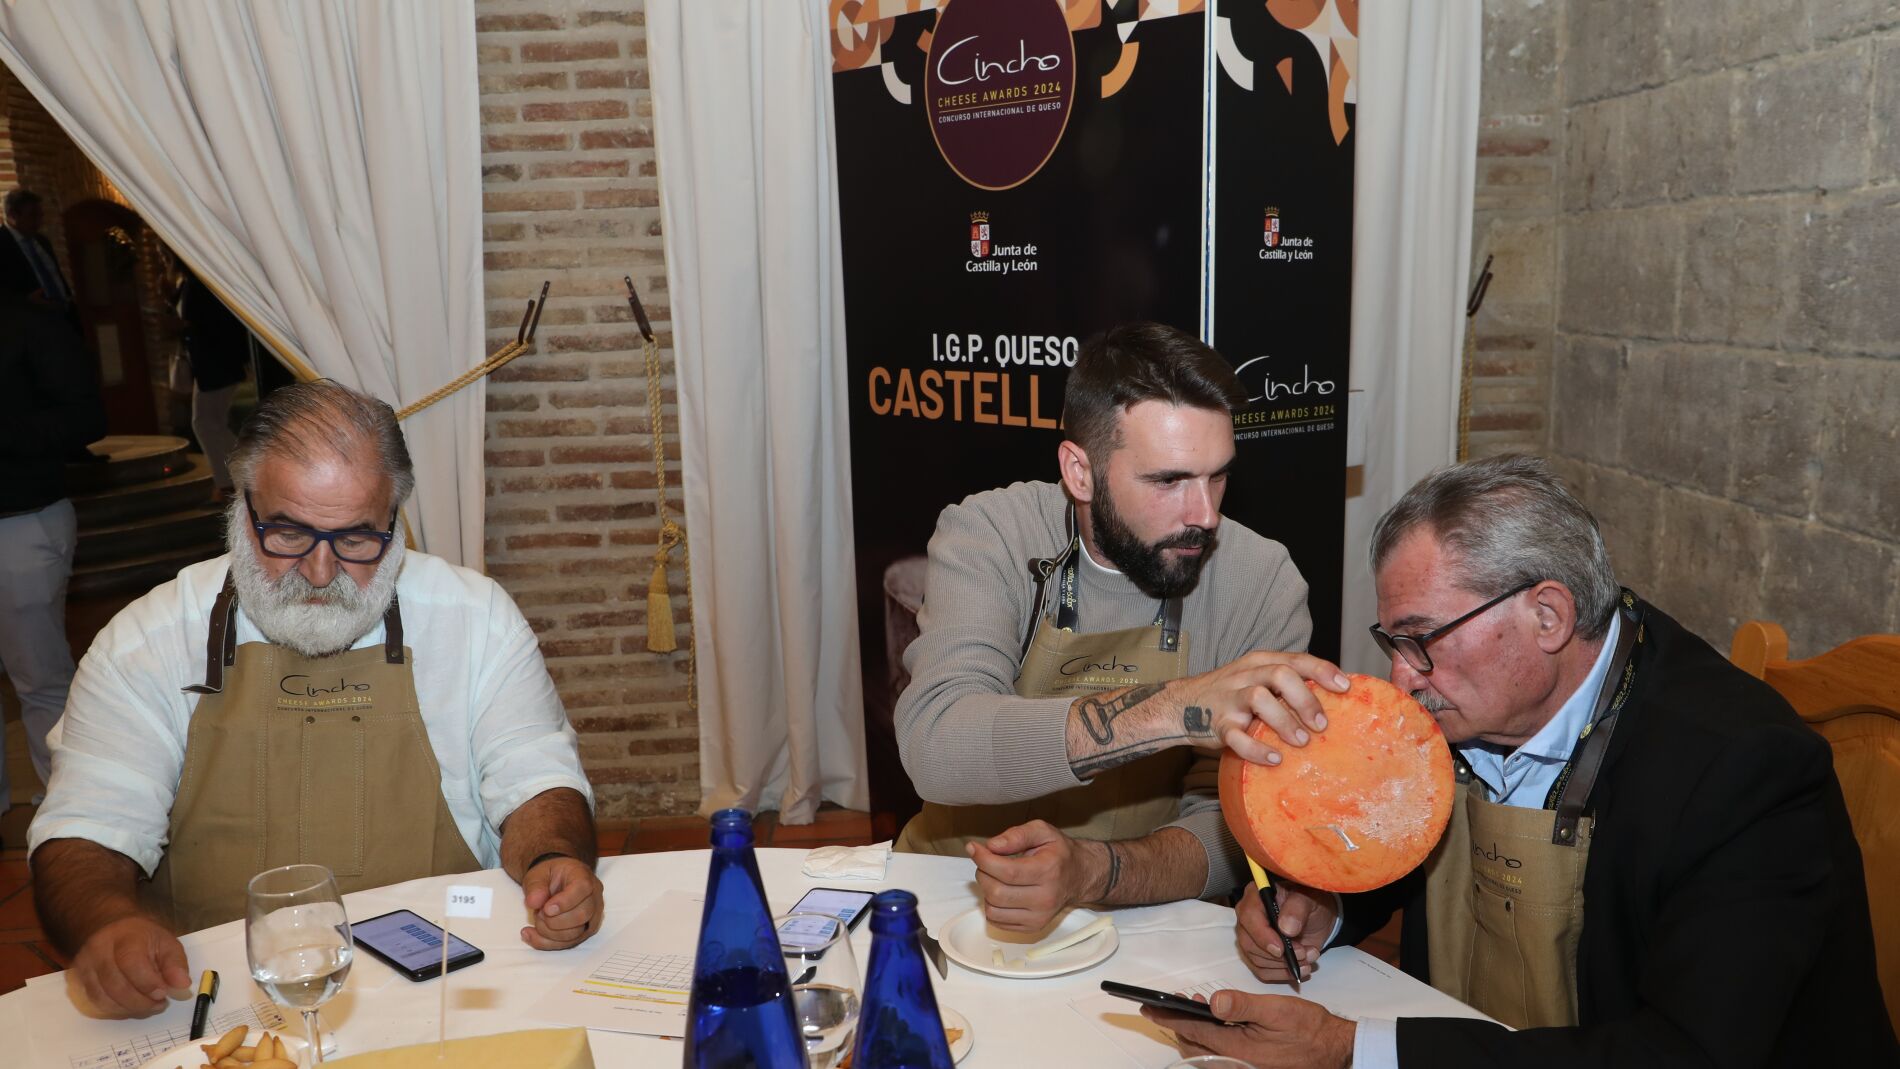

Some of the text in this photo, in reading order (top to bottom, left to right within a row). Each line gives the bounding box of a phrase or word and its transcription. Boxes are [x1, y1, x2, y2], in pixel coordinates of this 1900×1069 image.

[937, 35, 1060, 85] Cincho
[938, 81, 1061, 108] CHEESE AWARDS 2024
[938, 102, 1061, 124] CONCURSO INTERNACIONAL DE QUESO
[992, 244, 1037, 256] Junta de
[1280, 236, 1313, 247] Junta de
[1259, 249, 1313, 262] Castilla y León
[966, 259, 1038, 275] Castilla y León
[932, 333, 1079, 368] I.G.P. QUESO
[868, 366, 1065, 430] CASTELL
[1232, 404, 1335, 425] HEESE AWARDS 2024
[1232, 431, 1259, 441] ONCURSO
[1260, 426, 1305, 438] INTERNACIONAL
[280, 674, 370, 697] Cincho
[313, 697, 348, 706] AWARDS
[351, 695, 373, 704] 2024
[1472, 840, 1522, 868] incho
[451, 895, 476, 904] 3195
